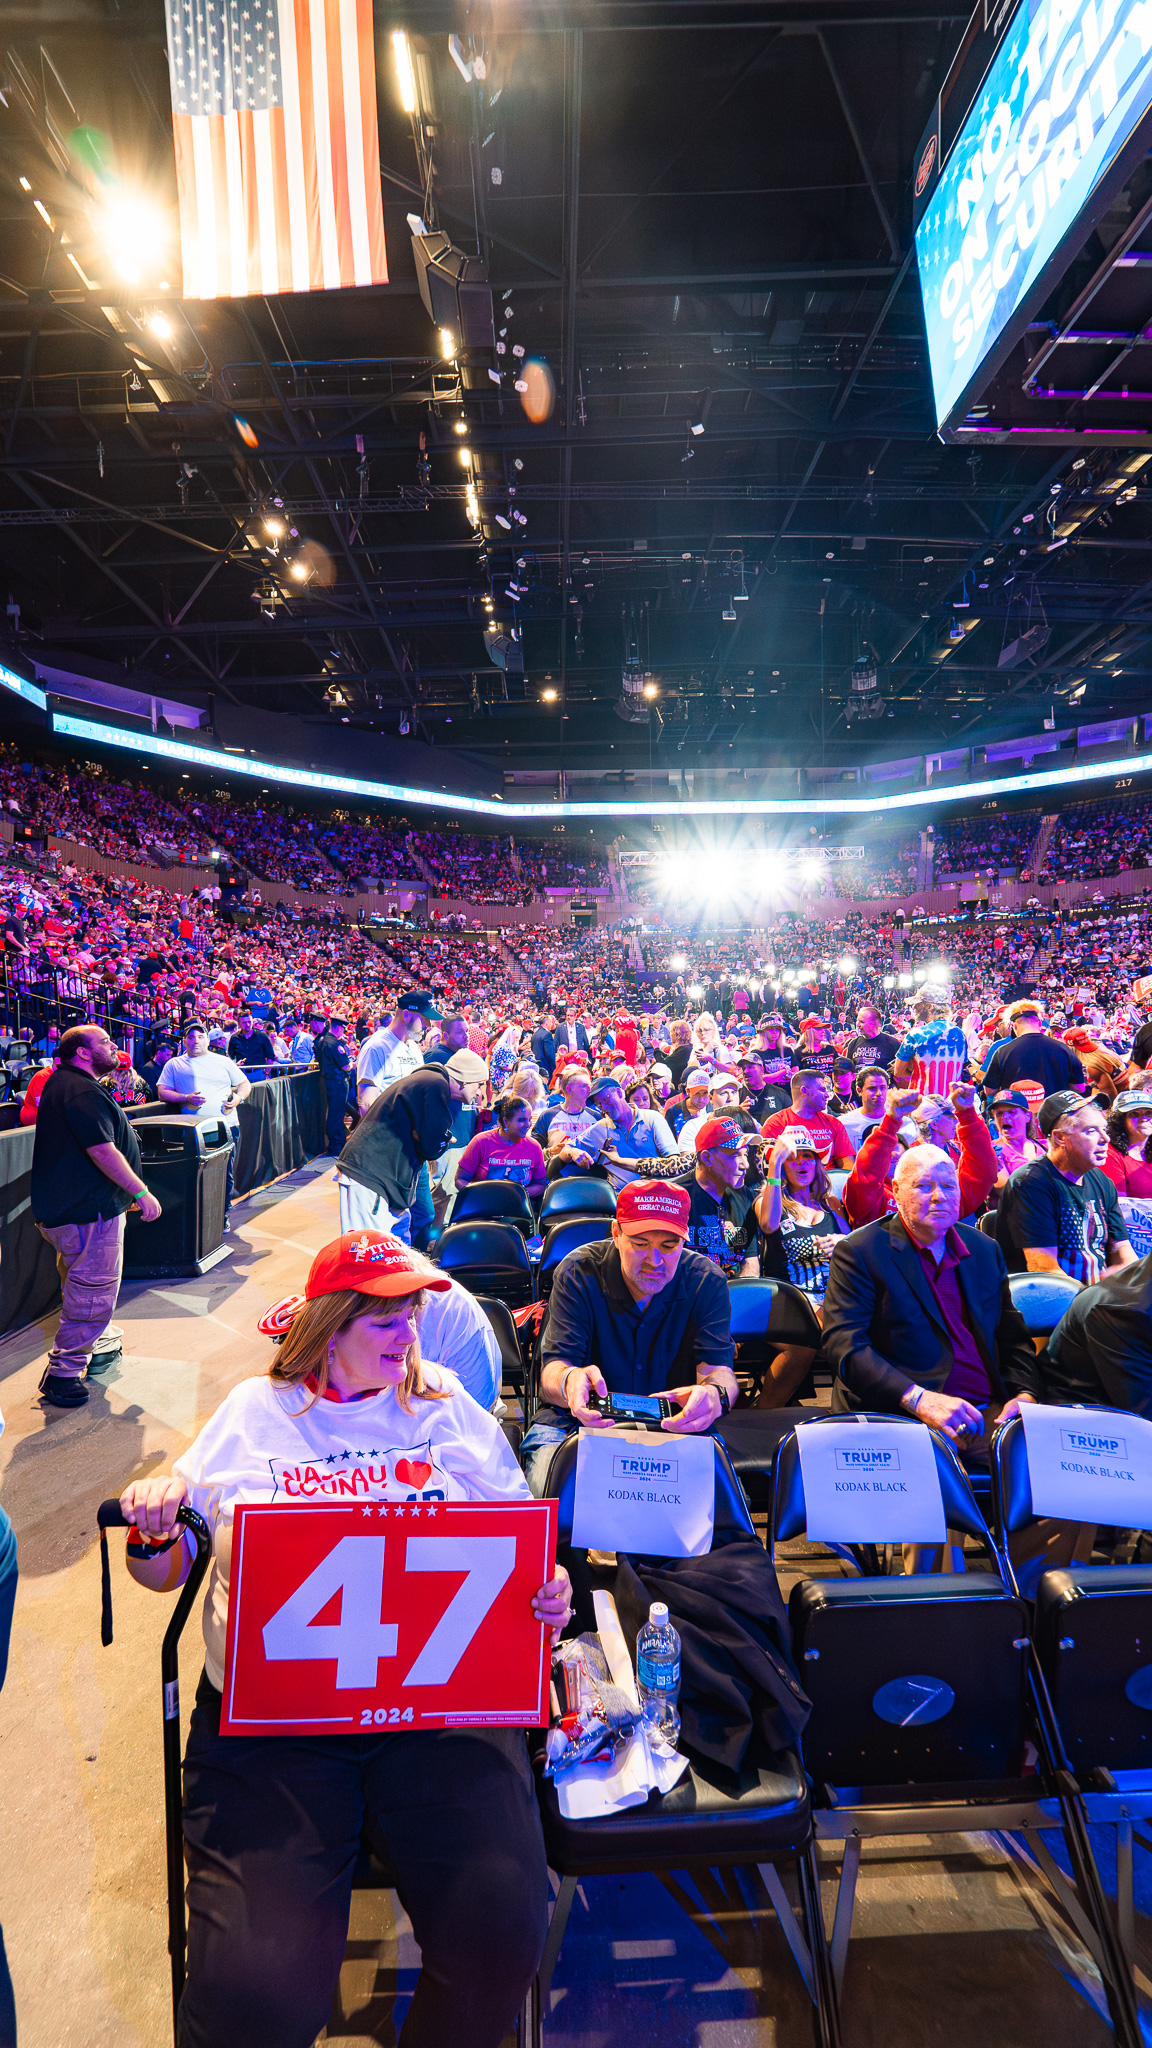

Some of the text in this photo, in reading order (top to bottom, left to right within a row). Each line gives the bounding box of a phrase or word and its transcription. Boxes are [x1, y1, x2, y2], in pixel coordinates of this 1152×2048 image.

[940, 0, 1120, 319] ON SOCI
[957, 102, 1012, 230] NO
[85, 761, 103, 772] 208
[157, 741, 357, 790] MAKE HOUSING AFFORDABLE AGAIN
[1048, 769, 1083, 782] MAKE
[1085, 759, 1143, 776] HOUSING
[1115, 778, 1132, 788] 217
[215, 790, 231, 799] 209
[404, 790, 431, 802] MAKE
[474, 802, 532, 814] AFFORDABLE
[533, 805, 563, 814] AGAIN
[982, 801, 997, 809] 216
[21, 896, 33, 906] 47
[852, 1051, 881, 1059] OFFICERS
[112, 1090, 147, 1105] ERIC
[555, 1122, 592, 1132] TRUMP
[794, 1138, 812, 1146] 024
[637, 1203, 680, 1215] GREAT AGAIN
[655, 1196, 682, 1208] AMERICA
[686, 1225, 696, 1245] I
[1067, 1433, 1119, 1451] TRUMP
[842, 1452, 892, 1463] TRUMP
[621, 1460, 671, 1474] TRUMP
[1060, 1461, 1136, 1482] KODAK BLACK
[834, 1482, 908, 1492] KODAK BLACK
[608, 1489, 682, 1505] KODAK BLACK
[262, 1536, 517, 1689] 47
[360, 1707, 414, 1726] 2024
